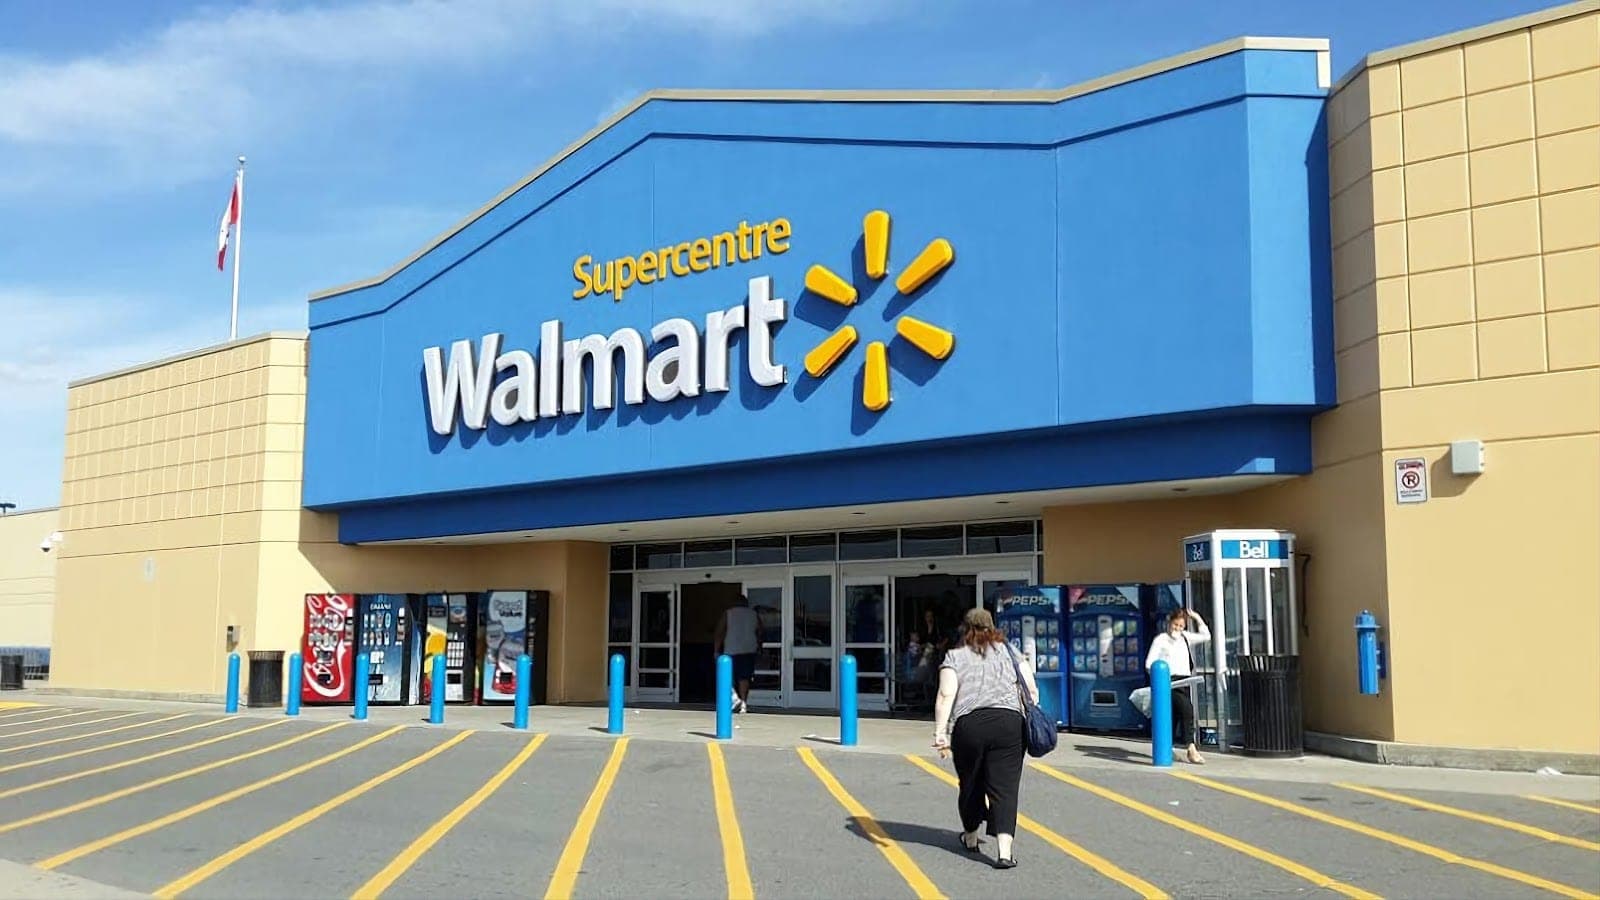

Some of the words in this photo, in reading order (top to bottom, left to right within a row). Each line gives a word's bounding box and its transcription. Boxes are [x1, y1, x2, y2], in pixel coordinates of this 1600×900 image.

[573, 217, 792, 301] Supercentre
[423, 276, 788, 435] Walmart
[1240, 540, 1269, 559] Bell
